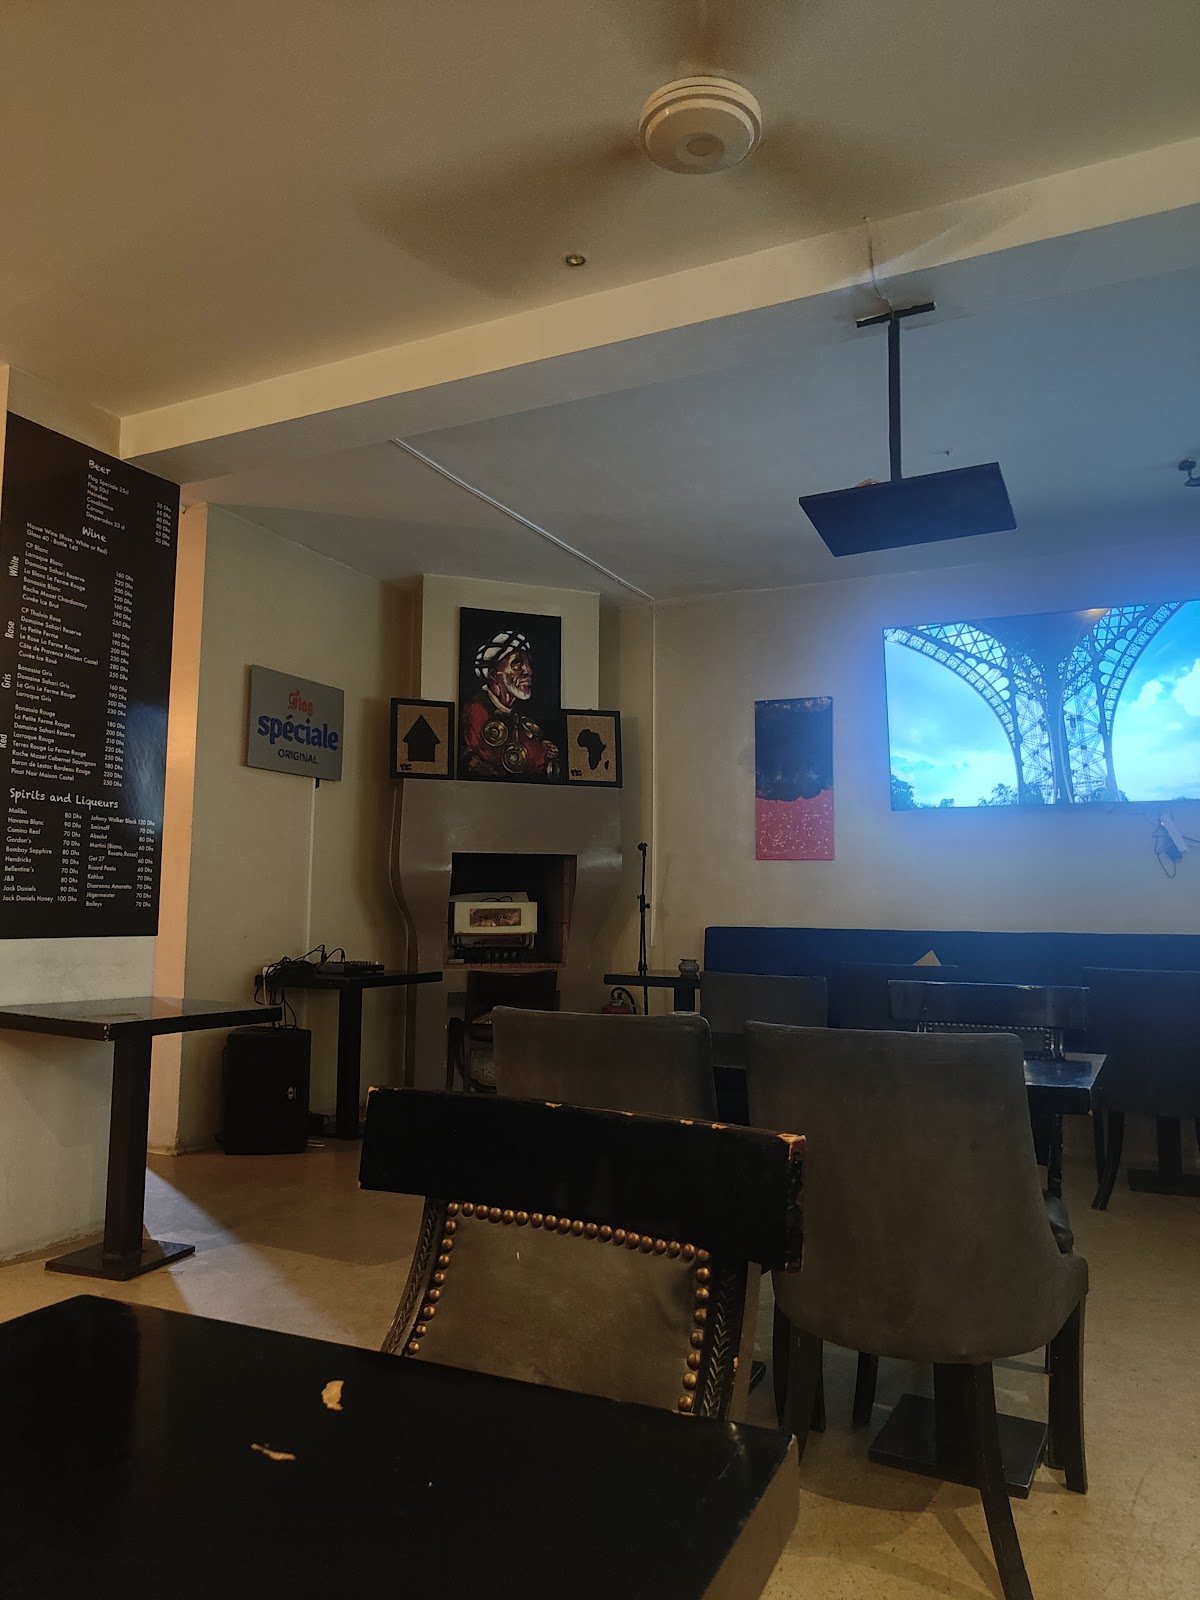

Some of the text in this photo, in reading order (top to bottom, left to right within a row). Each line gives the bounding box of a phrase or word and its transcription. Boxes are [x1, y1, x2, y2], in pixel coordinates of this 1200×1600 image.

[89, 459, 111, 476] Beer
[88, 482, 98, 491] Flag
[86, 504, 104, 514] Corona
[27, 523, 43, 532] House
[82, 526, 107, 542] Wine
[26, 530, 41, 538] Glass
[53, 539, 67, 547] Bottle
[35, 545, 48, 554] Blanc
[25, 551, 64, 567] Larroque Blanc
[9, 556, 19, 577] White
[25, 559, 85, 582] Domaine Sahari Reserve
[24, 577, 46, 587] Bonassia
[32, 570, 46, 579] Blanc
[54, 577, 69, 586] Ferme
[70, 582, 86, 591] Rouge
[23, 585, 87, 609] Roche Mazet Chardonnay
[30, 609, 48, 619] Thalvin
[5, 620, 15, 638] Rose
[20, 616, 82, 636] Domaine Sahari Reserve
[43, 630, 58, 638] Ferme
[65, 644, 80, 653] Rouge
[41, 647, 64, 657] Provence
[65, 652, 82, 661] Maison
[84, 657, 98, 665] Castel
[18, 664, 41, 674] Bonassia
[1, 673, 12, 688] Gris
[17, 673, 40, 682] Domaine
[42, 678, 58, 686] Sahari
[16, 691, 39, 700] Larroque
[60, 690, 76, 699] Rouge
[15, 704, 55, 717] Bonassia Rouge
[14, 723, 38, 731] Domaine
[54, 720, 70, 729] Rouge
[14, 732, 54, 744] Larroque Rouge
[257, 714, 338, 751] spéciale
[30, 743, 46, 752] Rouge
[71, 749, 86, 757] Rouge
[278, 748, 318, 764] ORIGINAL
[48, 754, 71, 763] Cabernet
[72, 758, 96, 767] Sauvignon
[76, 767, 91, 775] Rouge
[9, 788, 119, 810] Spirits and Liqueurs
[6, 846, 27, 854] Bombay
